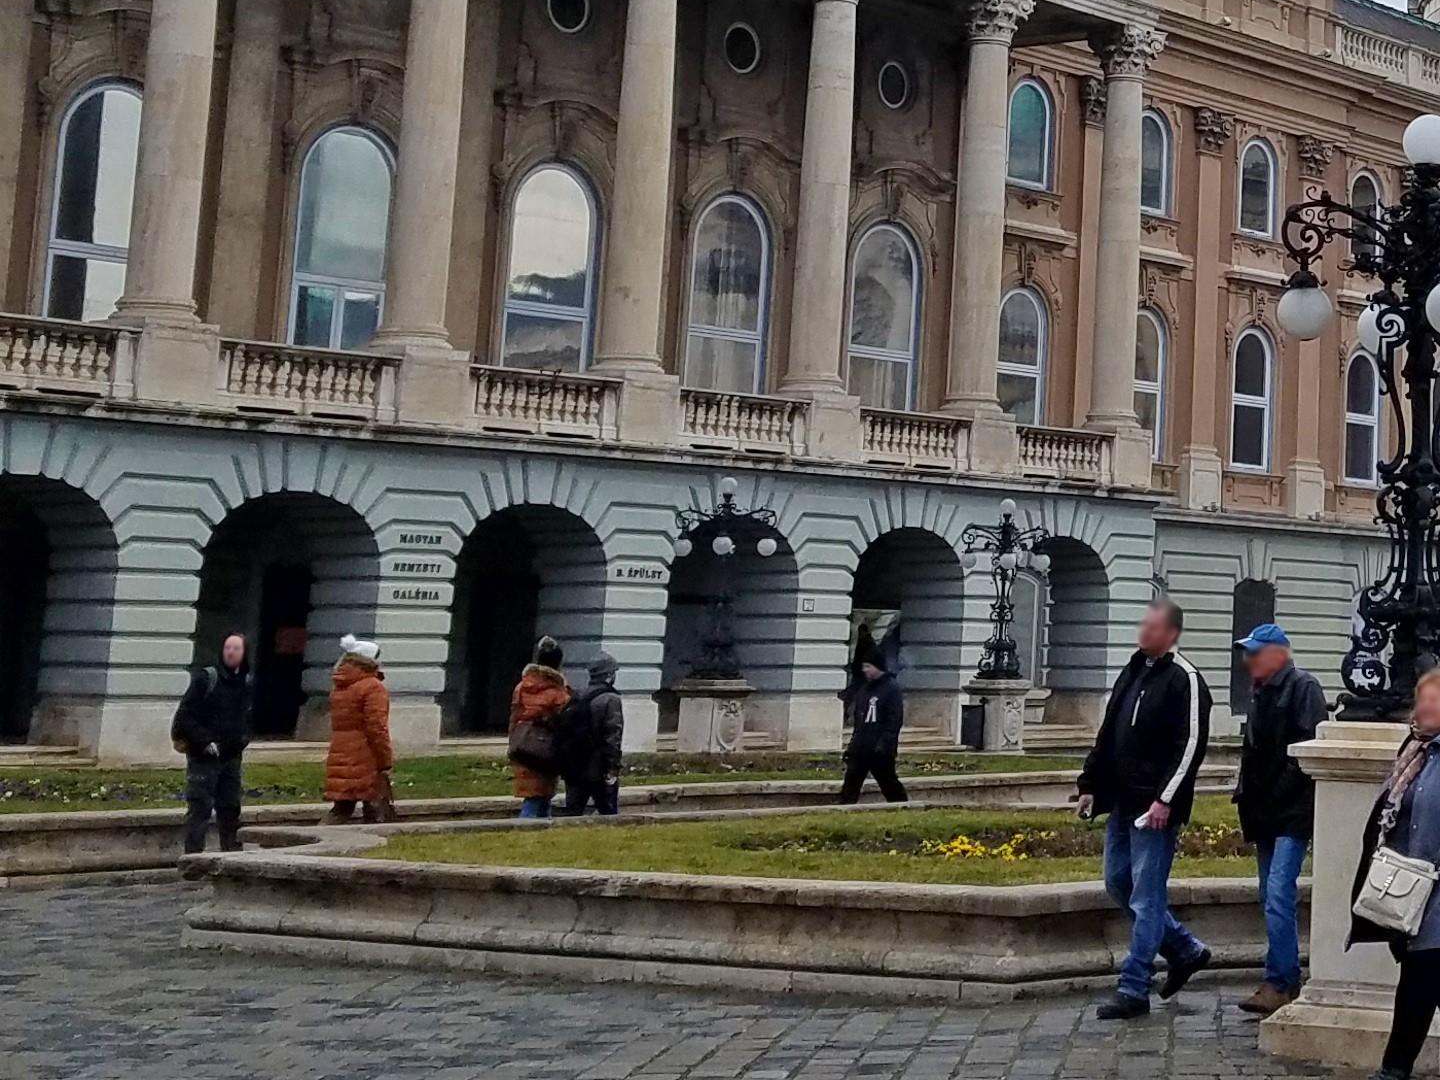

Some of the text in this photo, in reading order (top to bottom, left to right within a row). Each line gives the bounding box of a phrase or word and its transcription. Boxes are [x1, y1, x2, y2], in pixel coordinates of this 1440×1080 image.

[399, 533, 442, 545] MAGYAR
[392, 562, 442, 573] NEMZETI
[627, 567, 663, 579] ÉPÜLET
[392, 588, 440, 600] GALÉRIA
